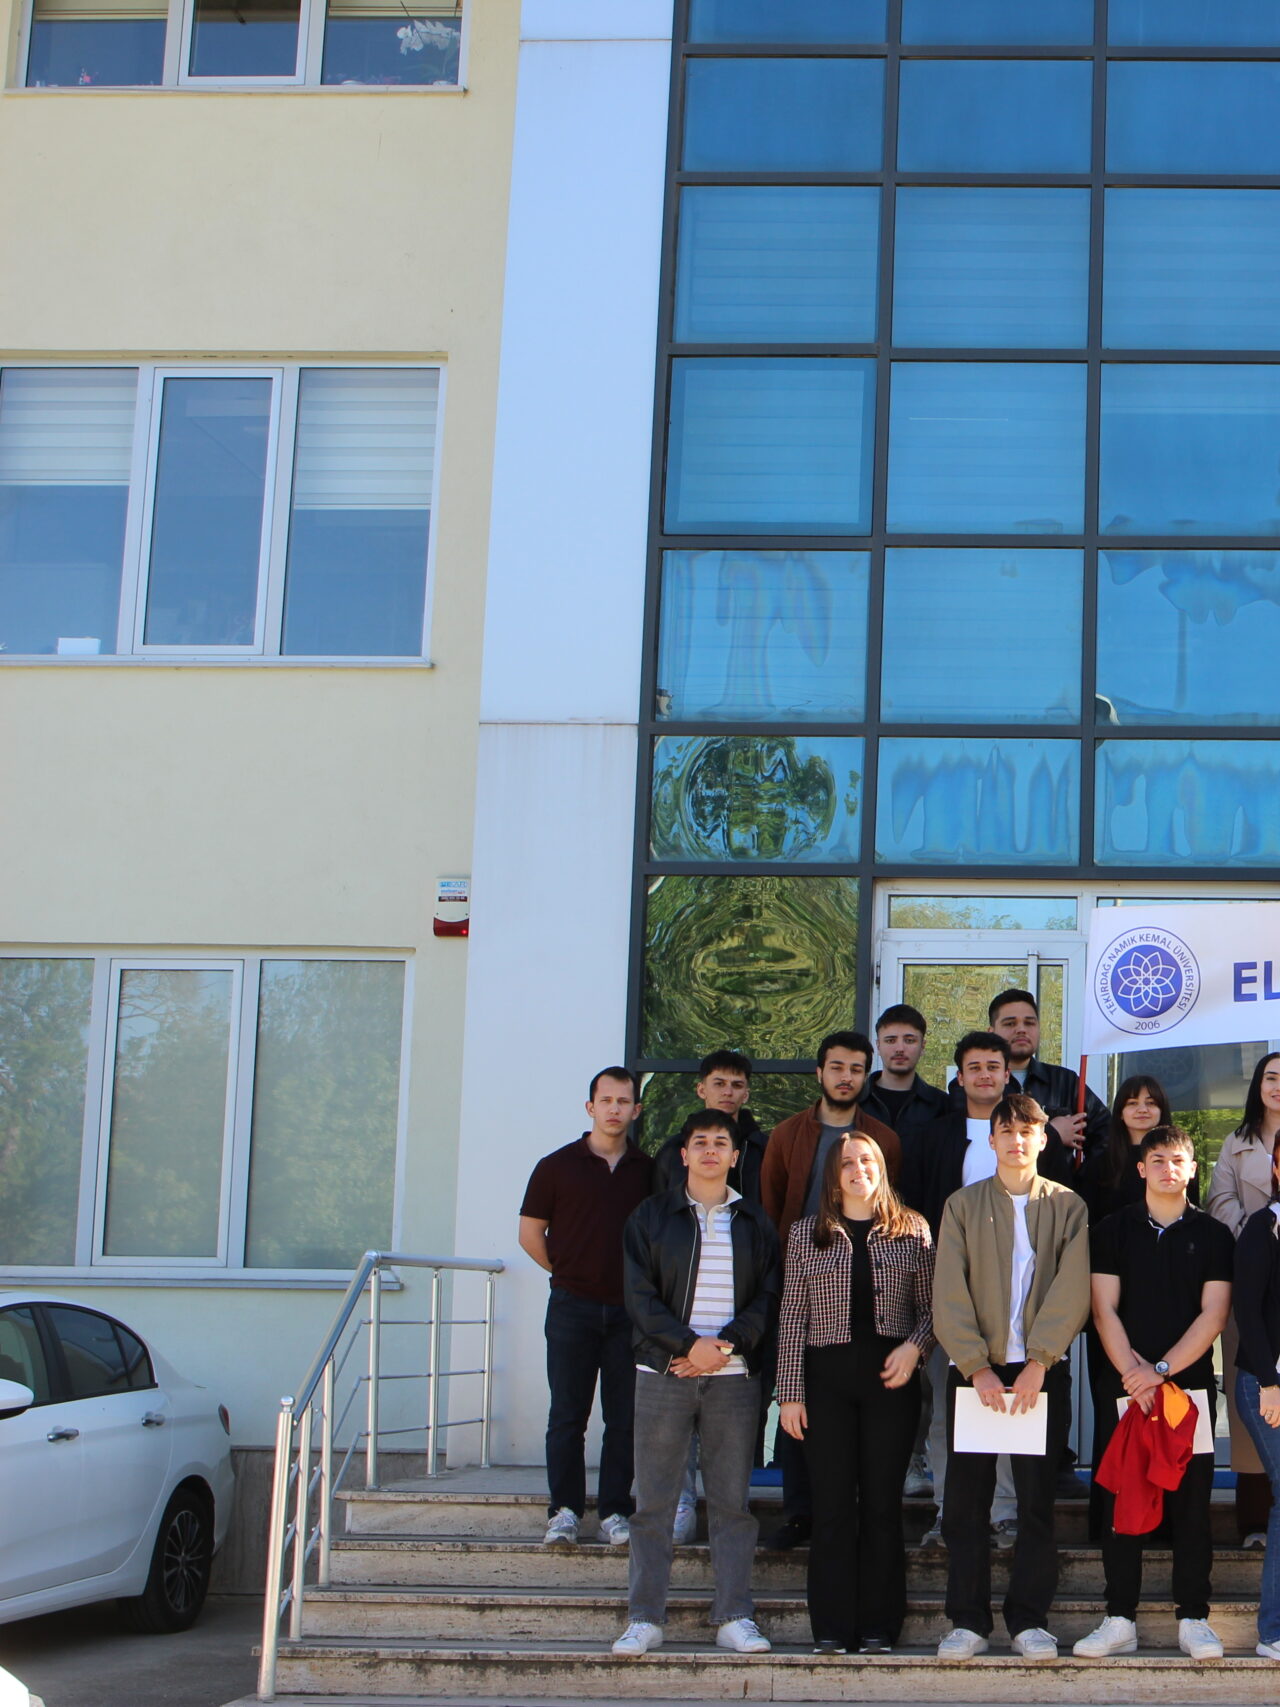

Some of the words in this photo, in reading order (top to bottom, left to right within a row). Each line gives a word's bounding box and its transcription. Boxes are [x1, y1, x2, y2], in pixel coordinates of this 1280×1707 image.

[1108, 935, 1137, 962] NAMIK
[1139, 933, 1172, 950] KEMAL
[1134, 1020, 1160, 1031] 2006
